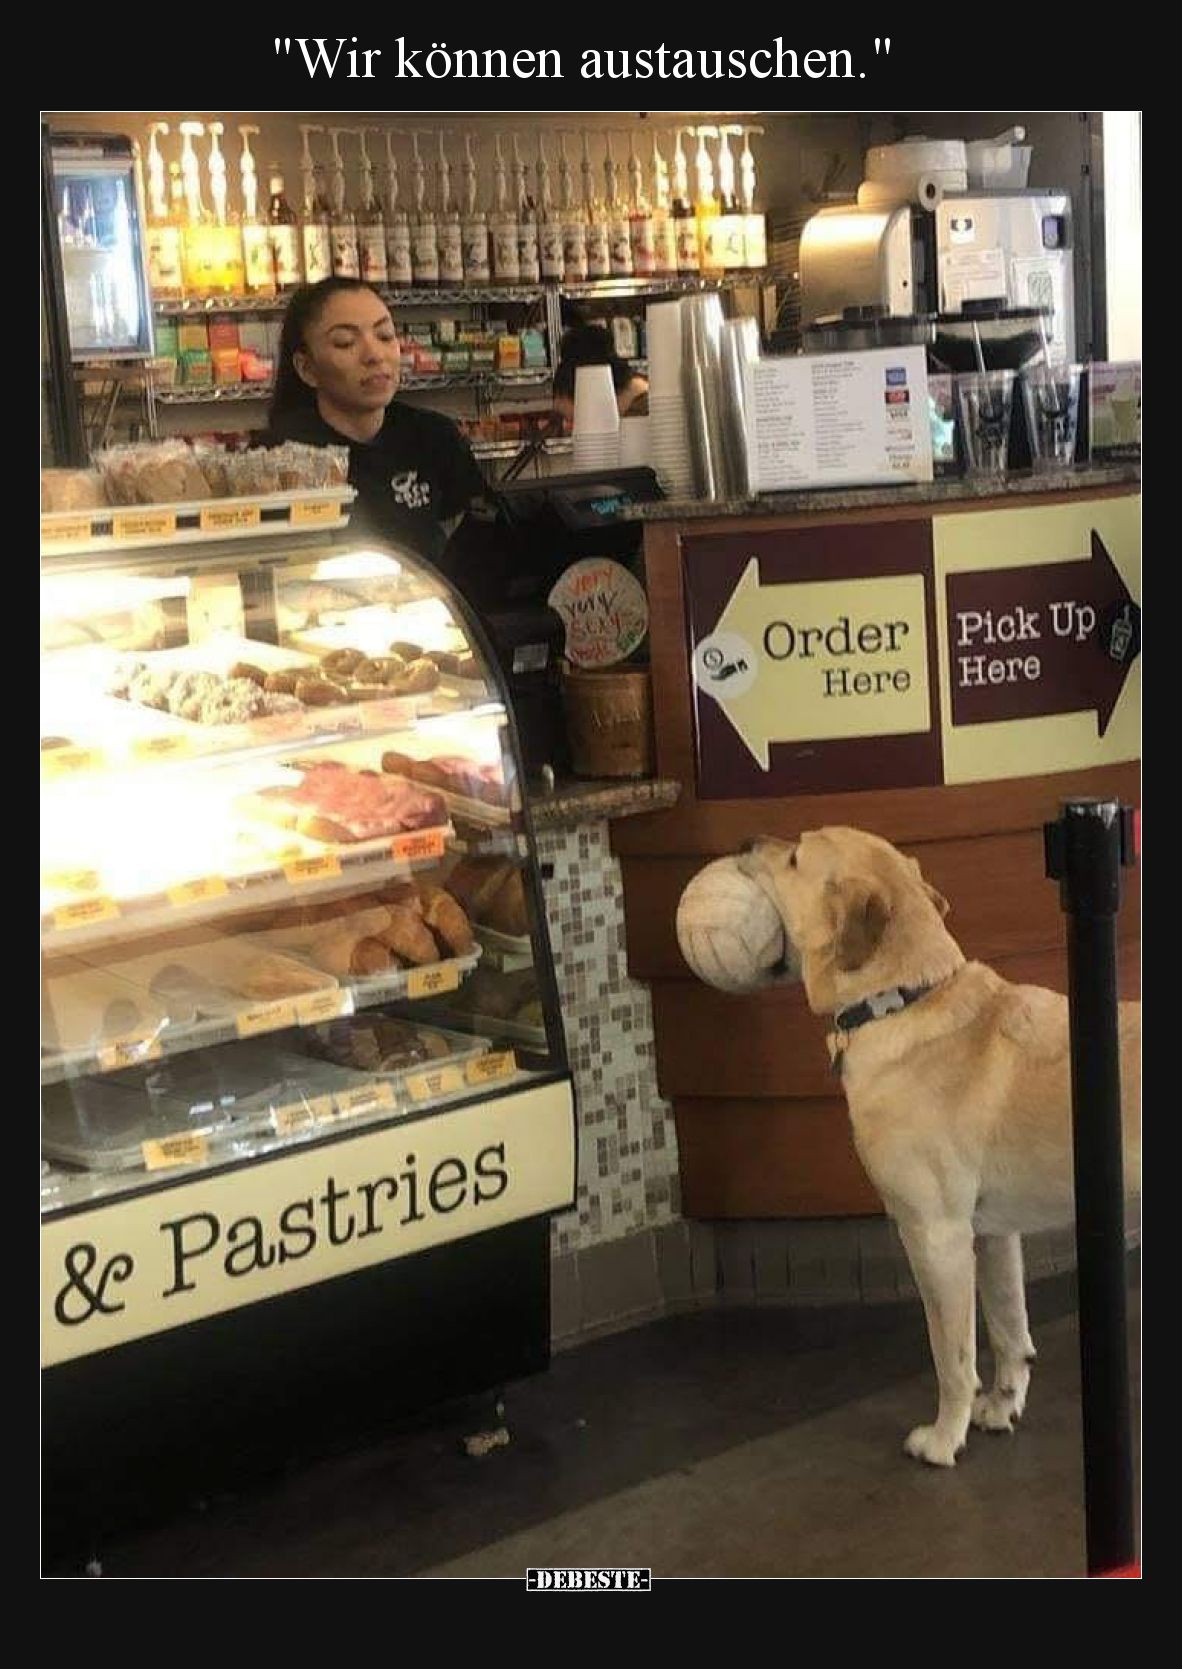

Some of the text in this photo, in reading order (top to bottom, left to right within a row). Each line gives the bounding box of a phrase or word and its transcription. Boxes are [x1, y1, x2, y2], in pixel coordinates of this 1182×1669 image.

[763, 616, 910, 661] Order
[956, 601, 1096, 646] Pick Up
[822, 667, 911, 698] Here
[957, 655, 1041, 687] Here
[54, 1141, 509, 1327] & Pastries
